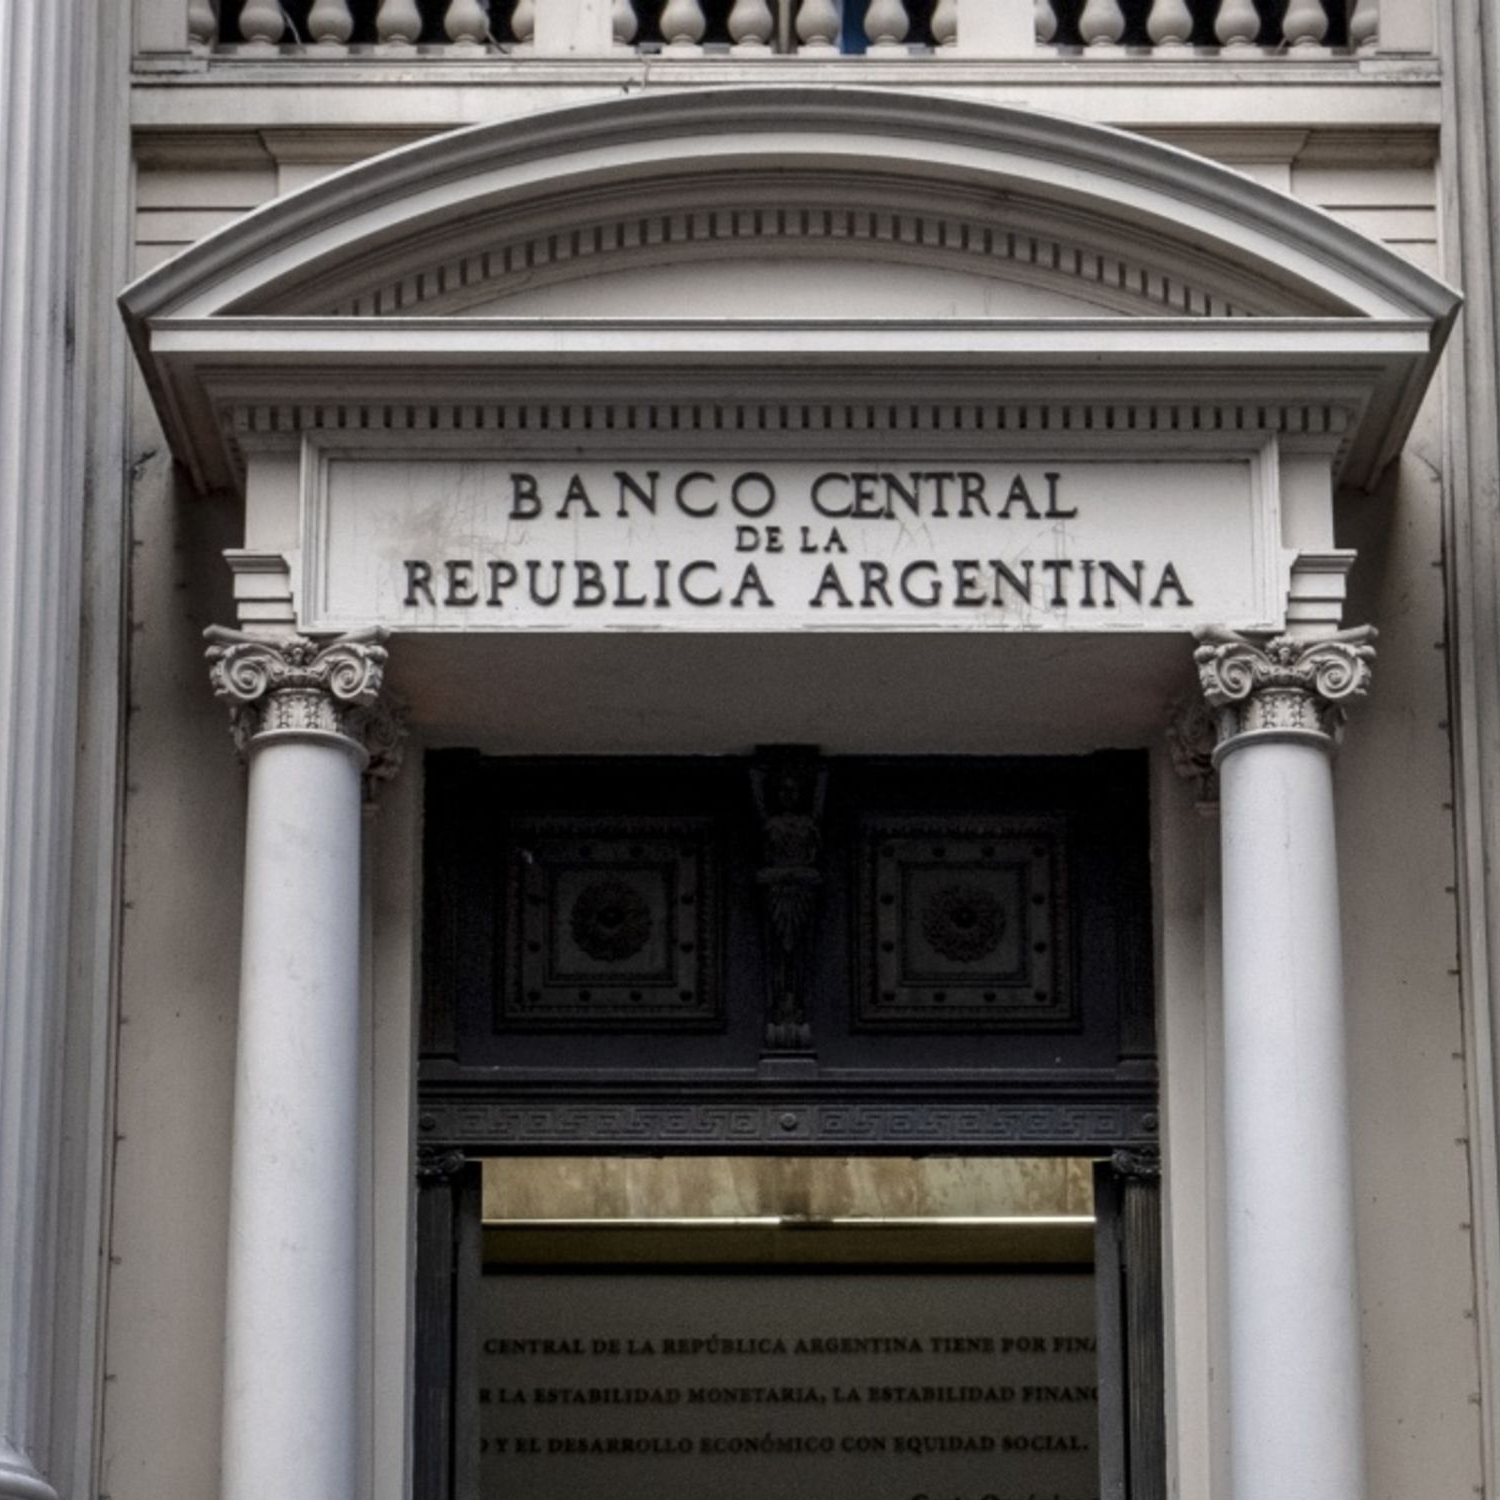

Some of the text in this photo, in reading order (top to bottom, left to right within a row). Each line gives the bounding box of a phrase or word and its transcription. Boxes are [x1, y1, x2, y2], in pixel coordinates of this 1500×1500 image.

[509, 471, 1078, 518] BANCO CENTRAL
[736, 526, 848, 553] DE LA
[404, 560, 1193, 607] REPUBLICA ARGENTINA
[484, 1338, 585, 1354] CENTRAL
[592, 1338, 621, 1354] DE
[628, 1338, 655, 1354] LA
[662, 1333, 787, 1354] REPÚBLICA
[794, 1337, 923, 1353] ARGENTINA
[930, 1337, 994, 1353] TIENE
[1001, 1337, 1046, 1353] POR
[499, 1388, 526, 1403] LA
[534, 1388, 681, 1403] ESTABILIDAD
[688, 1387, 826, 1404] MONETARIA,
[832, 1387, 860, 1402] LA
[869, 1387, 1015, 1402] ESTABILIDAD
[497, 1438, 510, 1454] Y
[516, 1438, 541, 1454] EL
[548, 1438, 693, 1454] DESARROLLO
[700, 1432, 834, 1454] ECONÓMICO
[841, 1437, 885, 1452] CON
[894, 1437, 995, 1454] EQUIDAD
[1002, 1436, 1089, 1452] SOCIAL.
